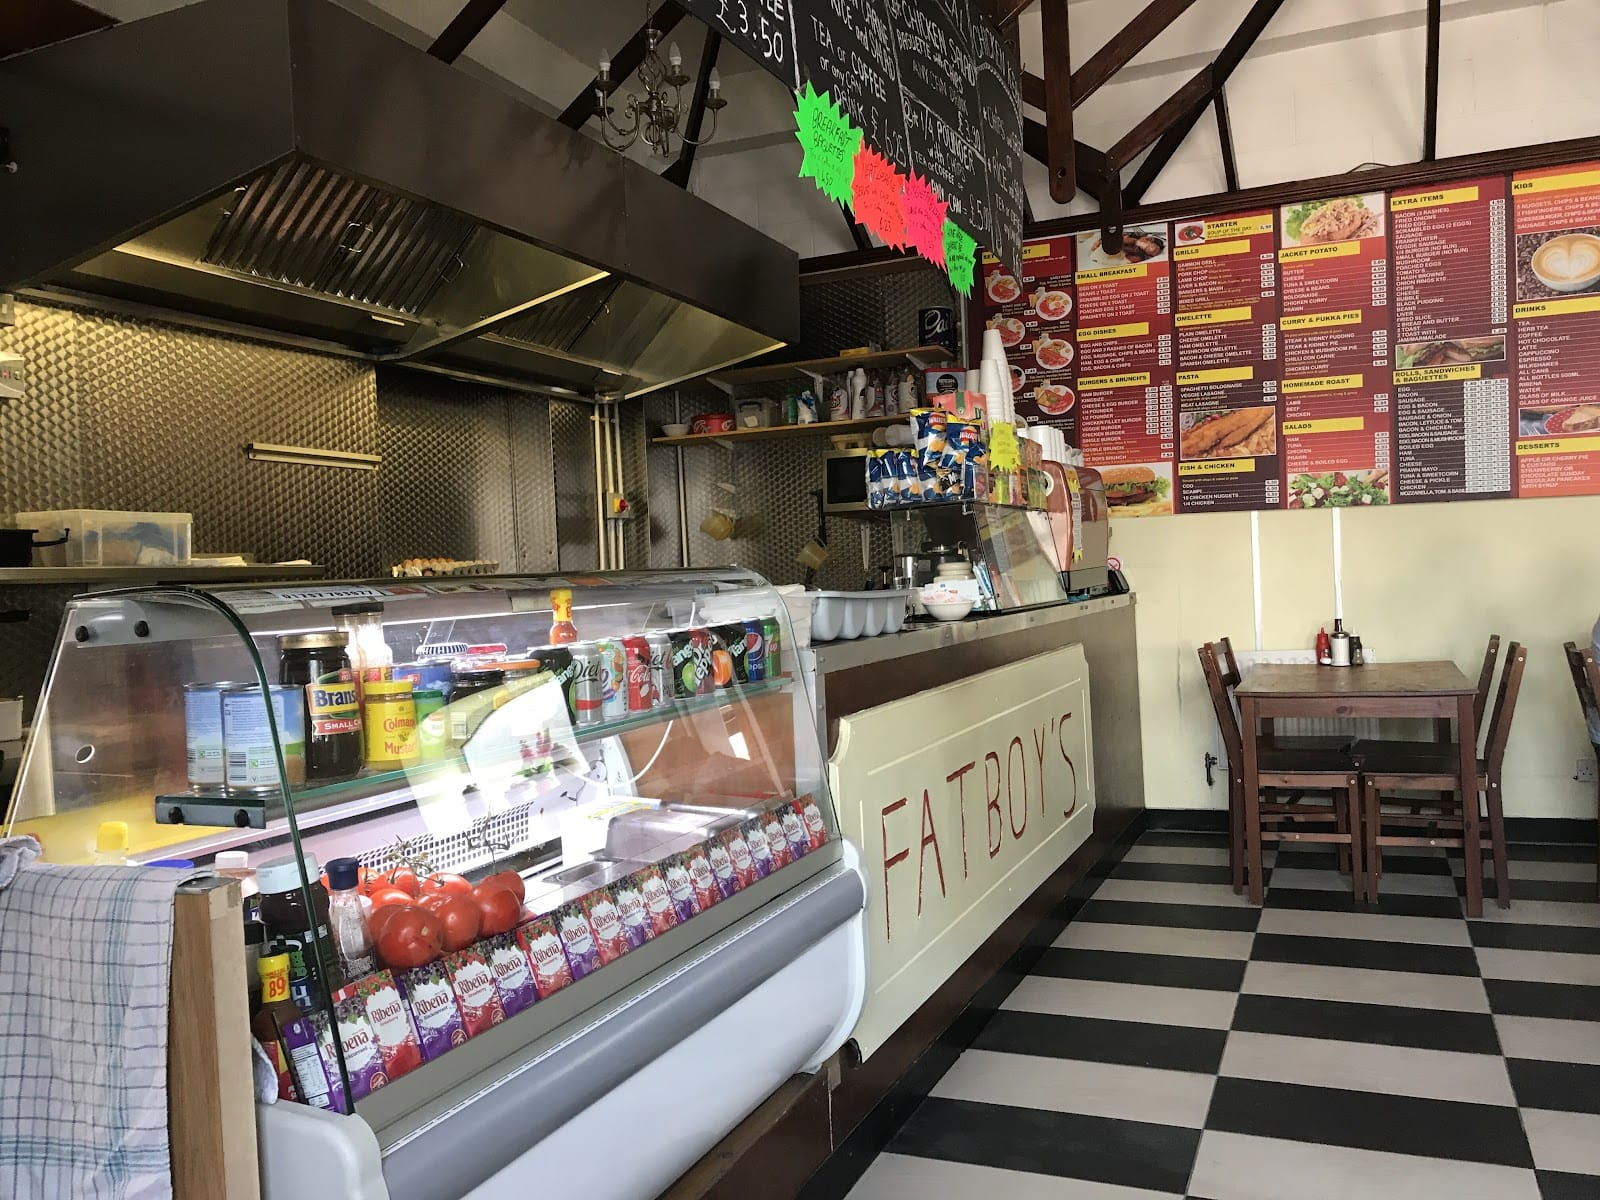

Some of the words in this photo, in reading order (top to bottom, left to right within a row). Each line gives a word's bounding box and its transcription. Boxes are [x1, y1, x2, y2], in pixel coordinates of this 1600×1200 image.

[810, 14, 834, 54] TEA
[851, 51, 887, 102] COFFEE
[1513, 182, 1533, 190] KIDS
[1392, 198, 1418, 206] EXTRA
[1420, 194, 1444, 202] ITEMS
[1207, 221, 1238, 230] STARTER
[1175, 248, 1200, 256] GRILLS
[1280, 250, 1308, 258] JACKET
[1309, 246, 1338, 255] POTATO
[1099, 268, 1137, 277] BREAKFAST
[1515, 305, 1546, 313] DRINKS
[1176, 313, 1212, 321] OMELETTE
[1282, 318, 1306, 326] CURRY
[1532, 335, 1570, 343] CHOCOLATE
[1423, 366, 1476, 375] SANDWICHES
[1079, 378, 1108, 386] BURGERS
[1403, 374, 1448, 383] BAGUETTES
[1283, 380, 1325, 389] HOMEMADE
[1517, 442, 1560, 450] DESSERTS
[324, 722, 353, 731] SMALL
[882, 712, 1077, 944] FATBOY'S
[645, 886, 666, 902] Ribena
[619, 899, 641, 916] Ribena
[593, 910, 617, 929] Ribena
[564, 924, 588, 943] Ribena
[534, 943, 561, 964] Ribena
[494, 956, 522, 978] Ribena
[268, 976, 287, 999] 89
[458, 972, 489, 995] Ribena
[415, 991, 449, 1016] Ribena
[370, 1000, 401, 1024] Ribena
